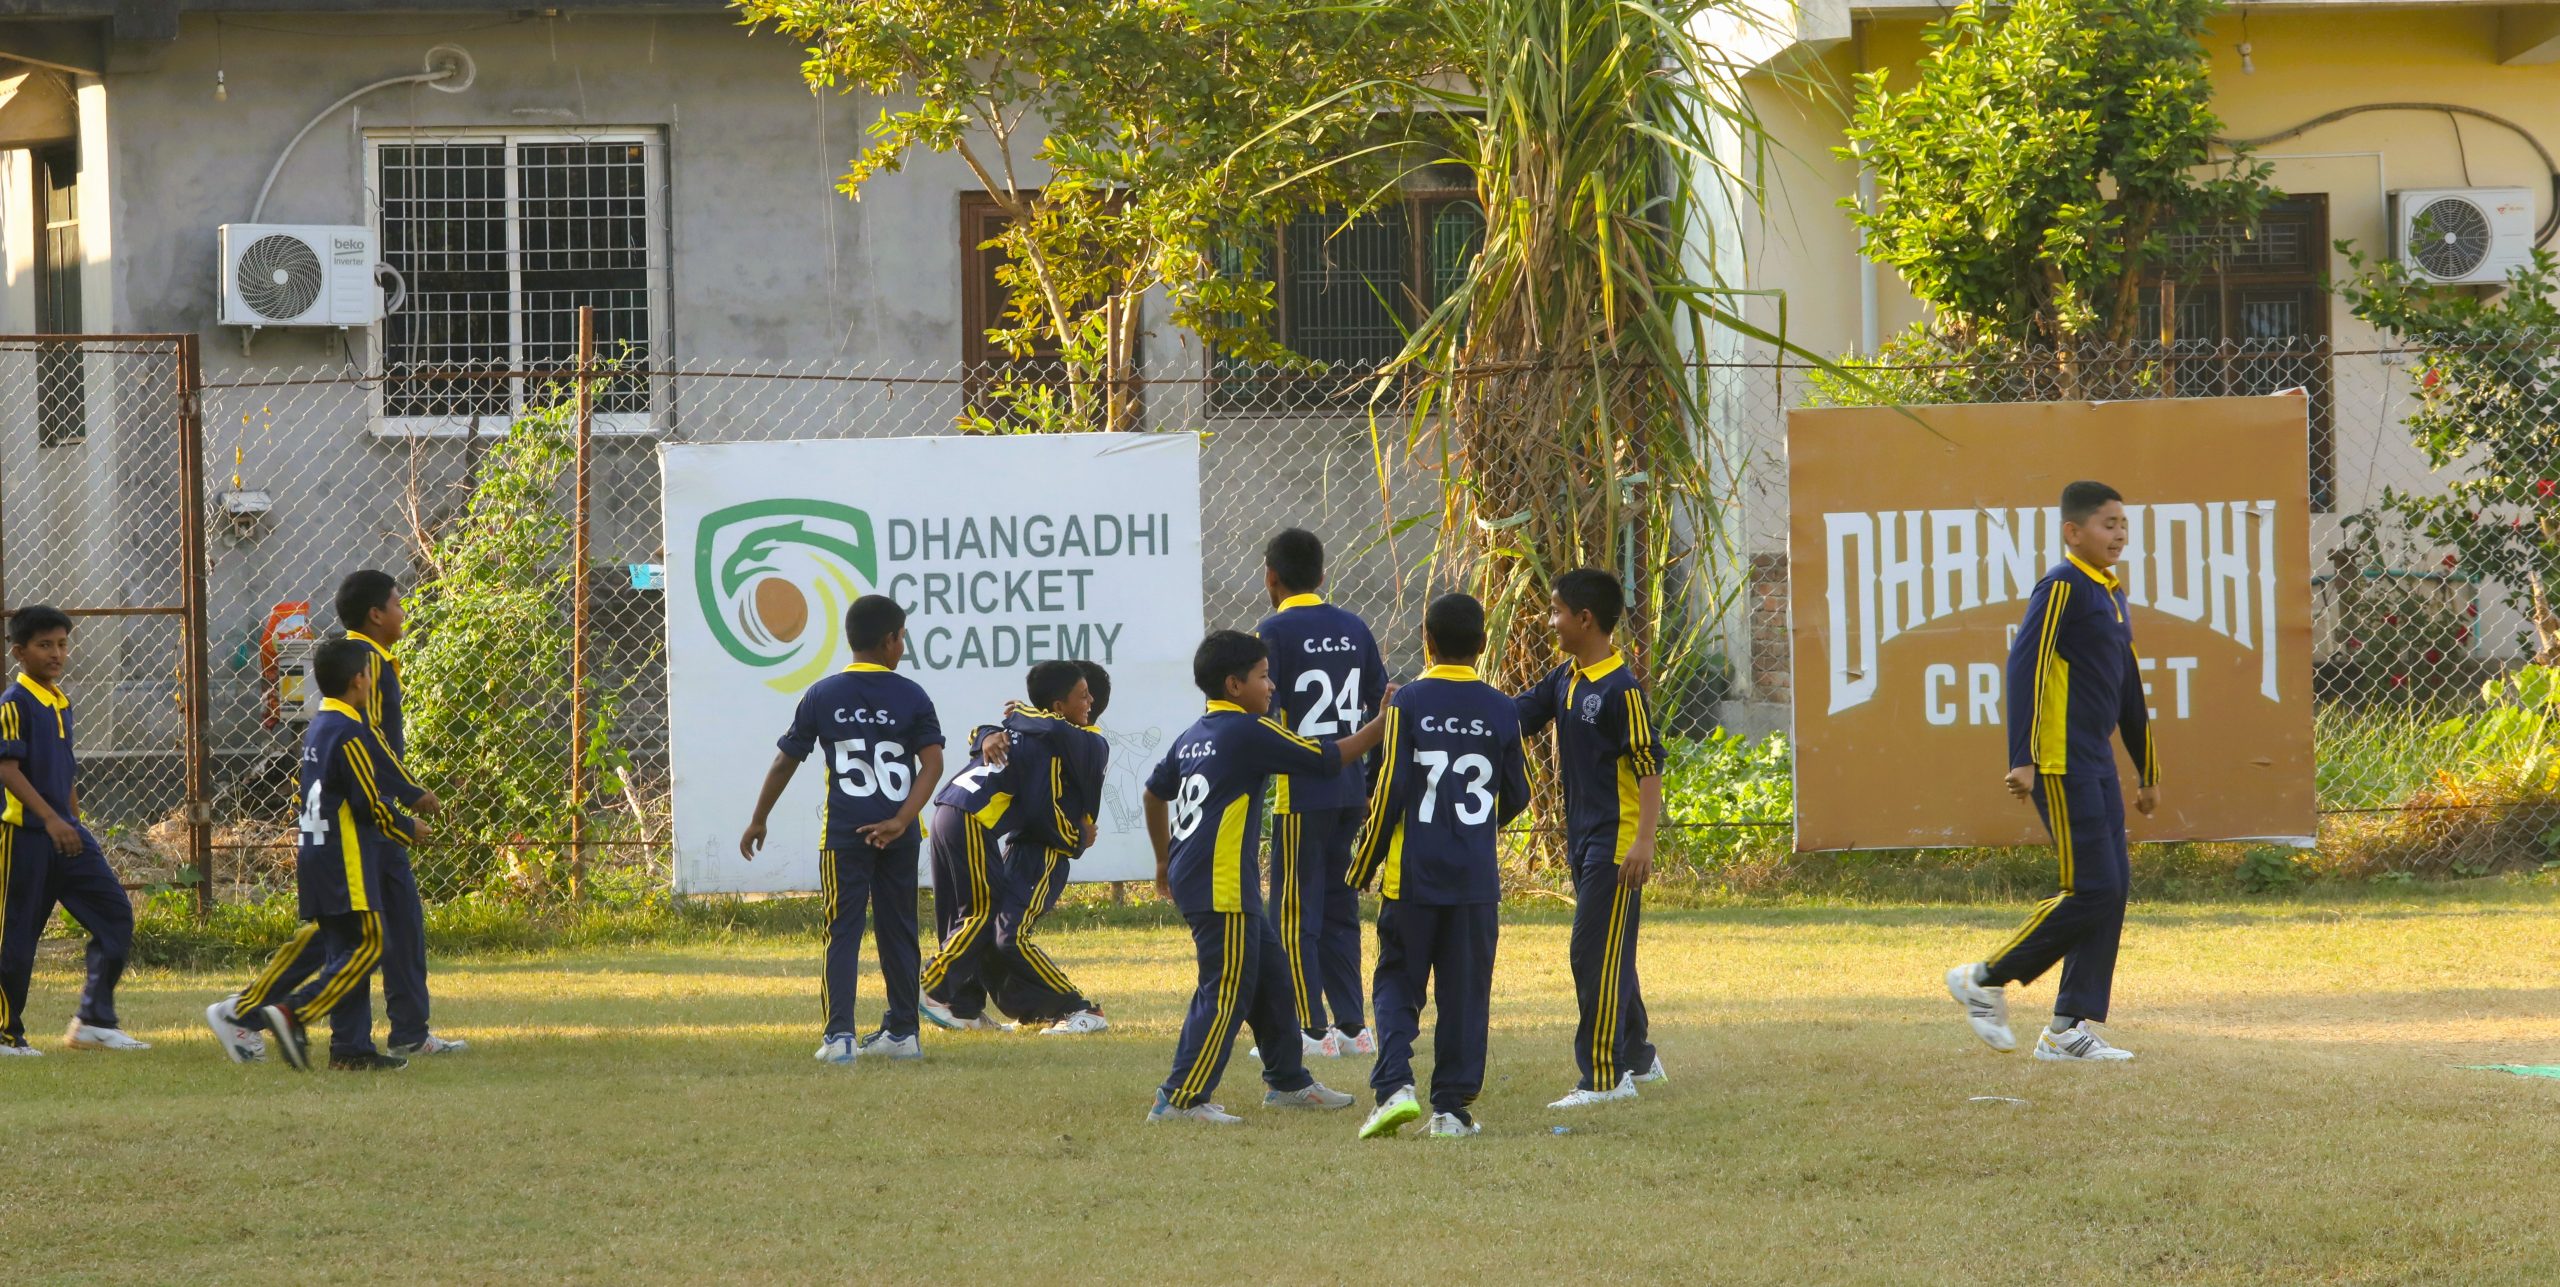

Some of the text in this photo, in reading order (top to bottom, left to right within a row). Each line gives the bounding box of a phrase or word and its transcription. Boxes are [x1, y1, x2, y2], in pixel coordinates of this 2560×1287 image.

[334, 238, 365, 249] beko
[888, 513, 1169, 561] DHANGADHI
[888, 569, 1094, 616] CRICKET
[1303, 636, 1357, 654] C.C.S.
[834, 707, 896, 725] C.C.S.
[1294, 667, 1362, 738] 24
[1419, 715, 1493, 737] C.C.S.
[1178, 740, 1217, 759] C.C.S.
[834, 738, 912, 802] 56
[1413, 747, 1494, 825] 73
